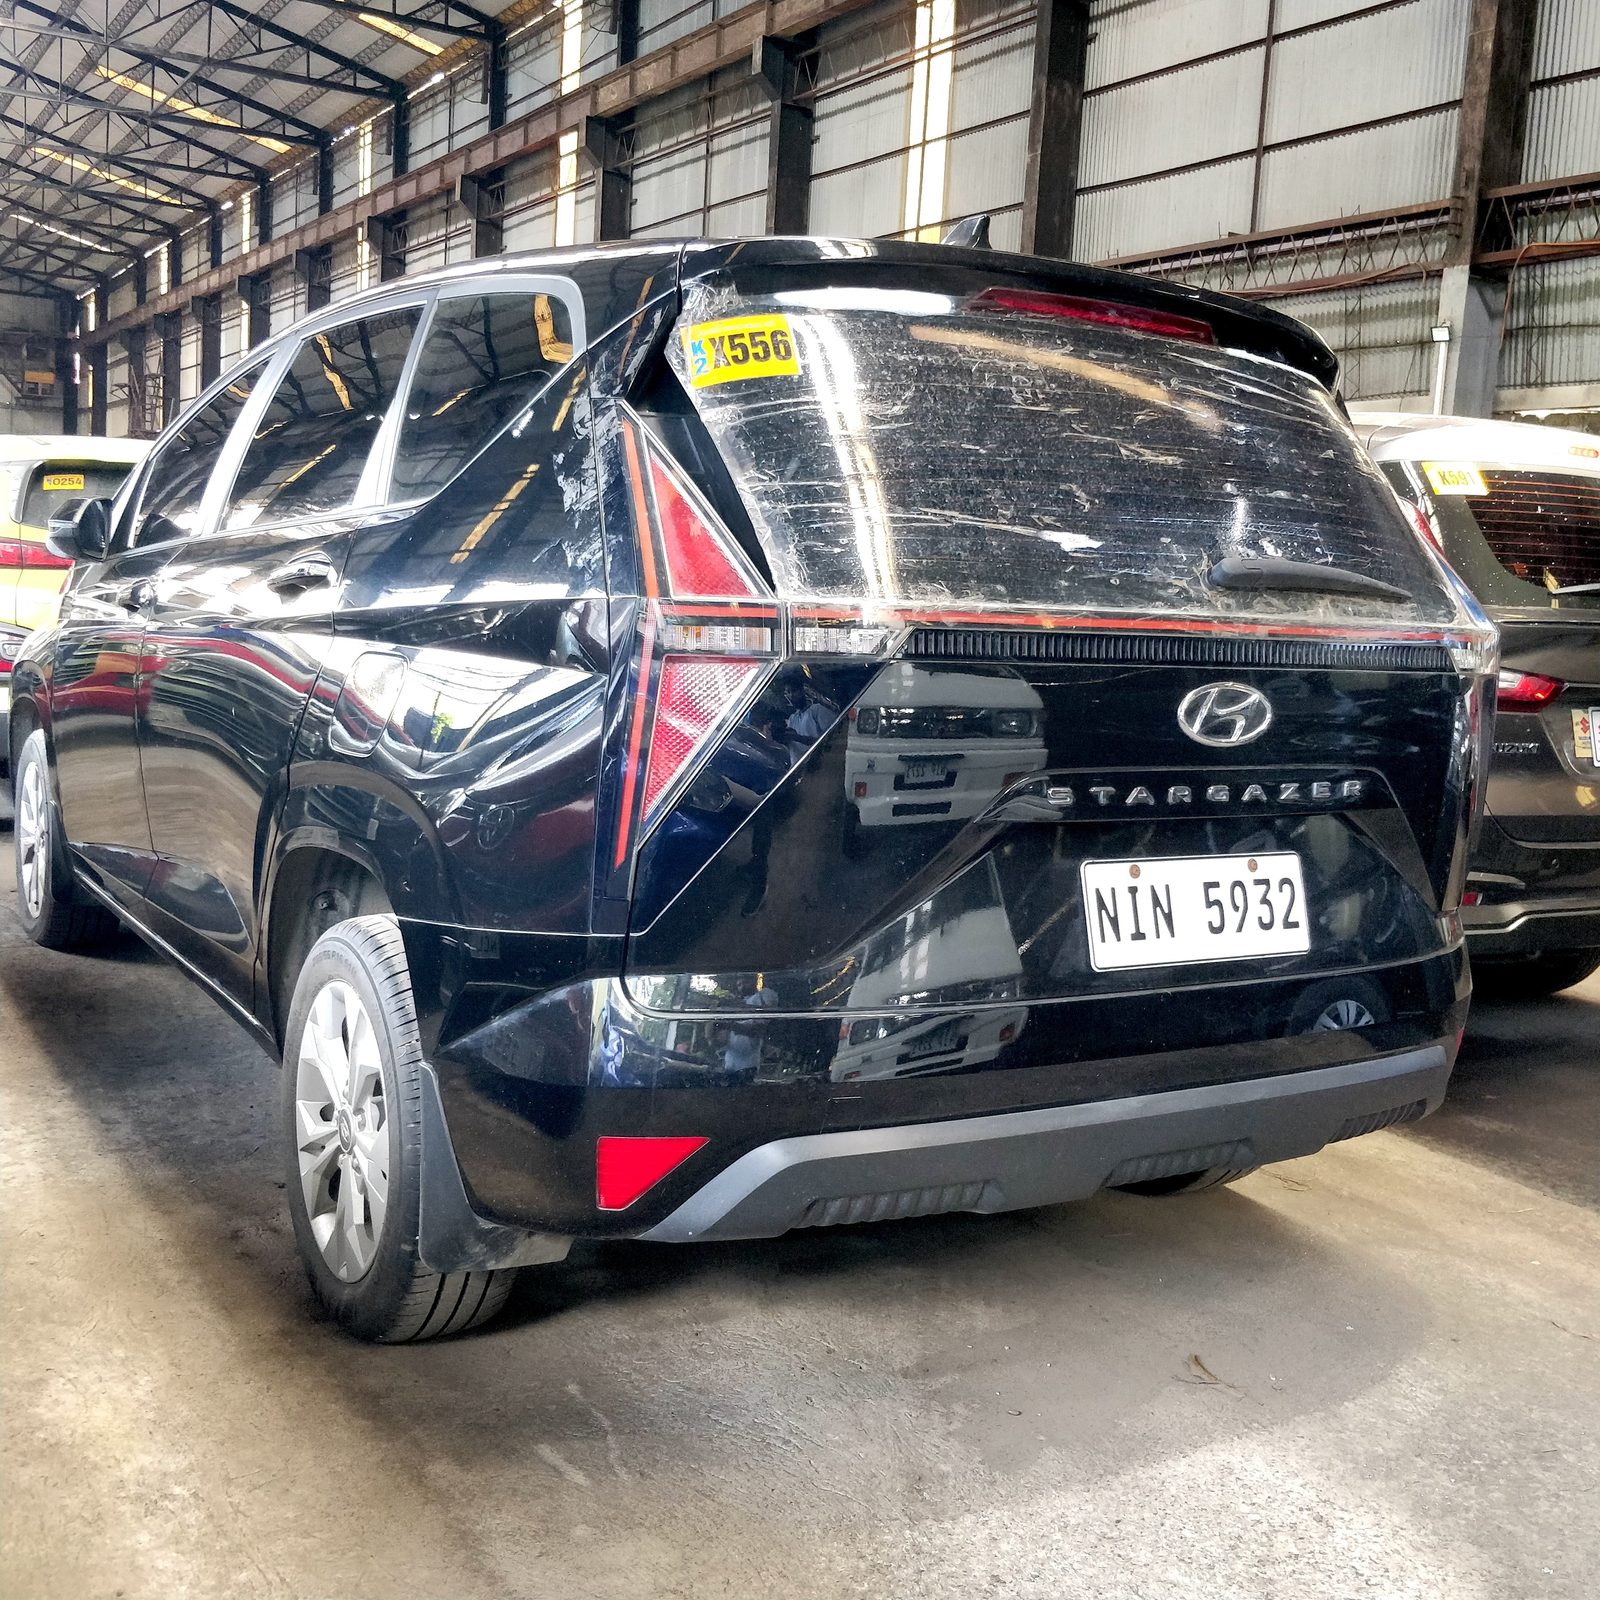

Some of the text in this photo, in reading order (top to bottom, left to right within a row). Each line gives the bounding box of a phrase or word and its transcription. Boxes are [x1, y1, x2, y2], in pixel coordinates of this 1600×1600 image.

[709, 329, 793, 370] X556
[1493, 742, 1539, 753] UZUKI
[1047, 780, 1362, 805] STARGAZER
[1095, 877, 1300, 943] NIN 5932
